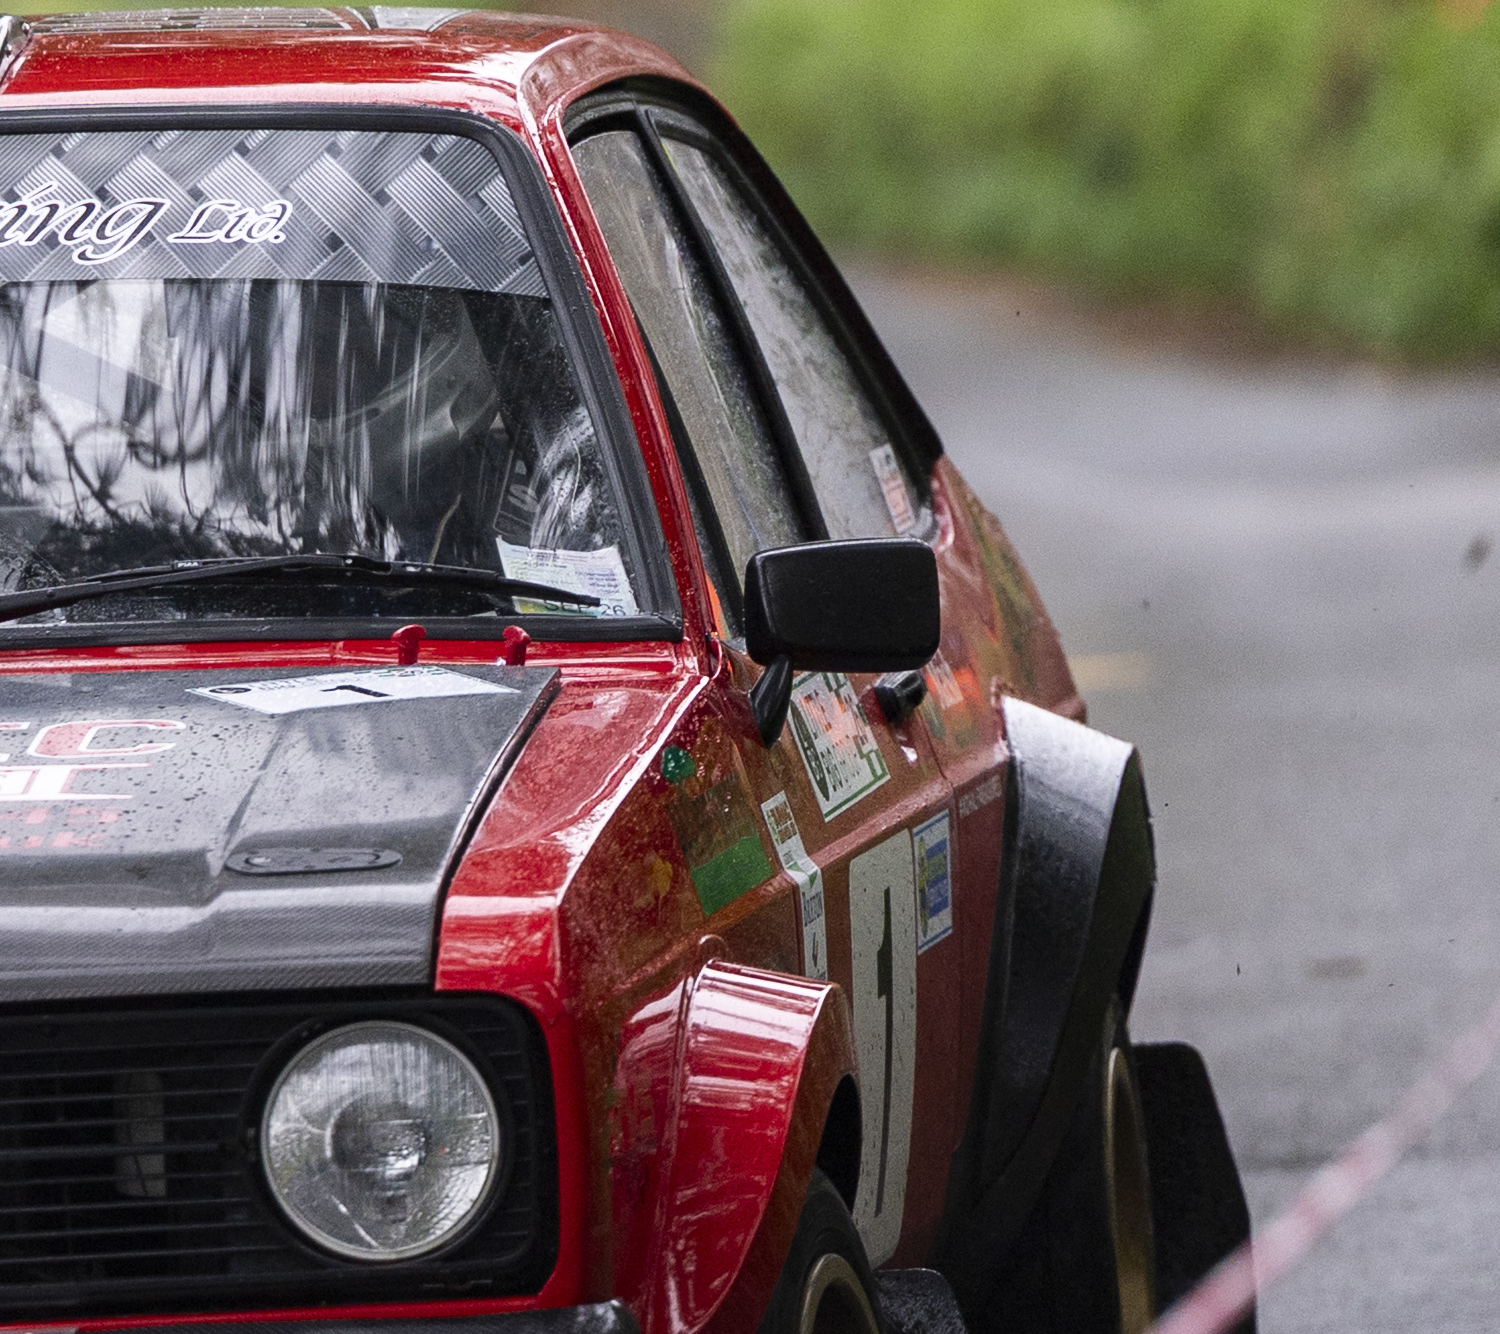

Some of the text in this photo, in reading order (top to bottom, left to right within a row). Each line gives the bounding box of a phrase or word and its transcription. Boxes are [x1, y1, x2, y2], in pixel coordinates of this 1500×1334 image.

[167, 198, 292, 244] Ltd.
[600, 604, 626, 616] 26
[875, 887, 893, 1218] 1
